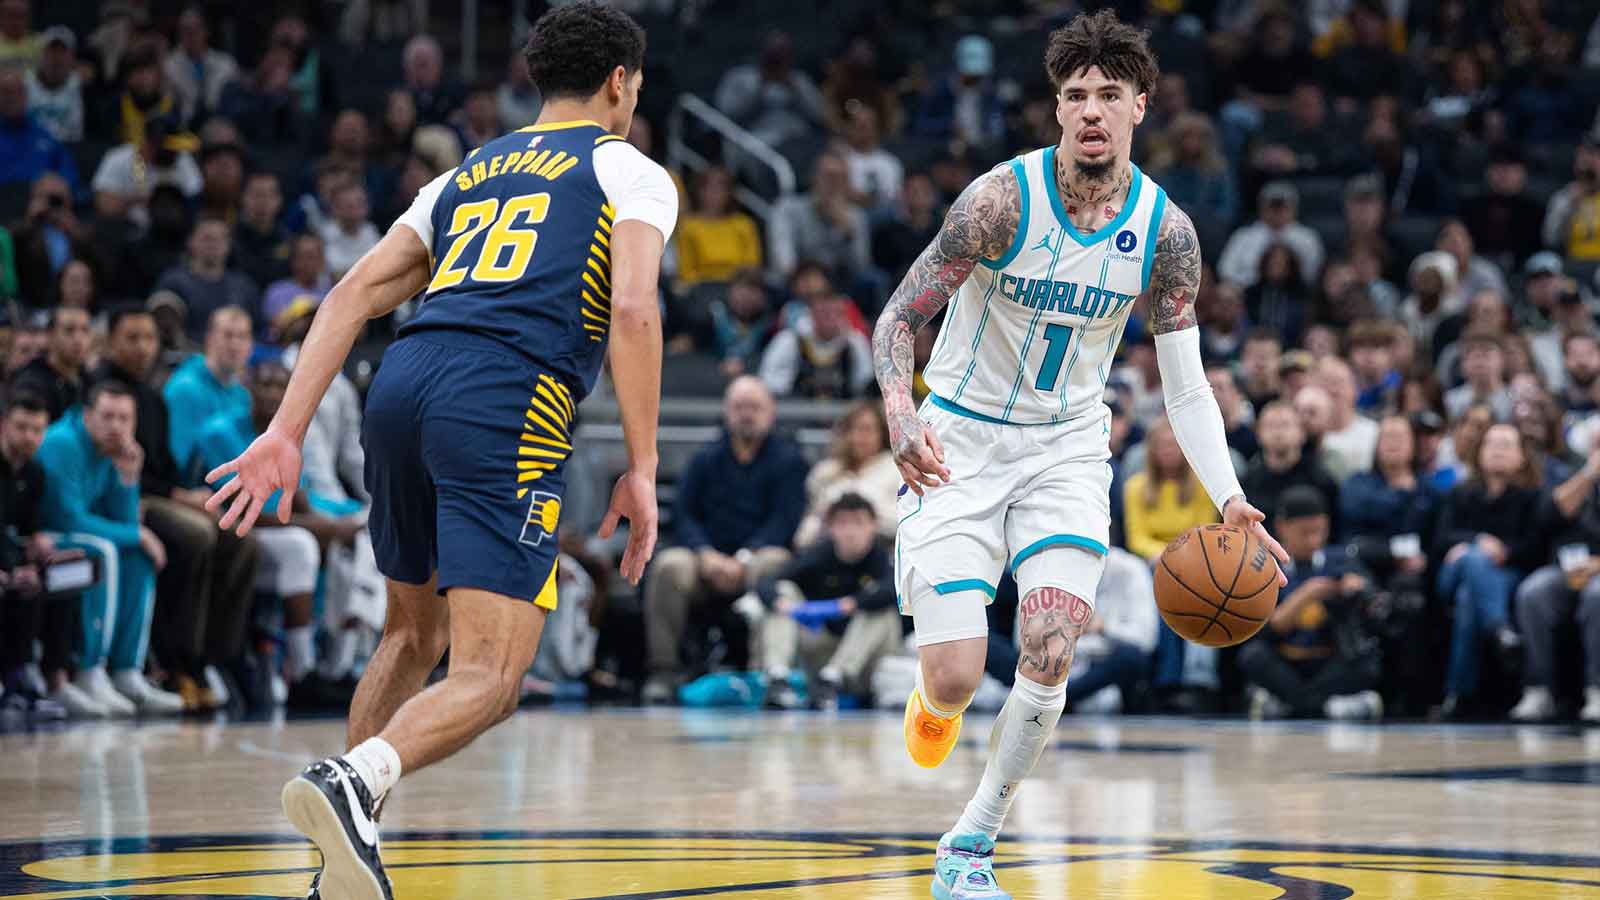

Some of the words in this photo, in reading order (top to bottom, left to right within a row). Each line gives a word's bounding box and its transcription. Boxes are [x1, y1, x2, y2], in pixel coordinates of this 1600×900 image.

[426, 192, 550, 294] 26
[1121, 254, 1143, 264] Health
[999, 272, 1136, 318] CHARLOTT
[1035, 323, 1073, 391] 1
